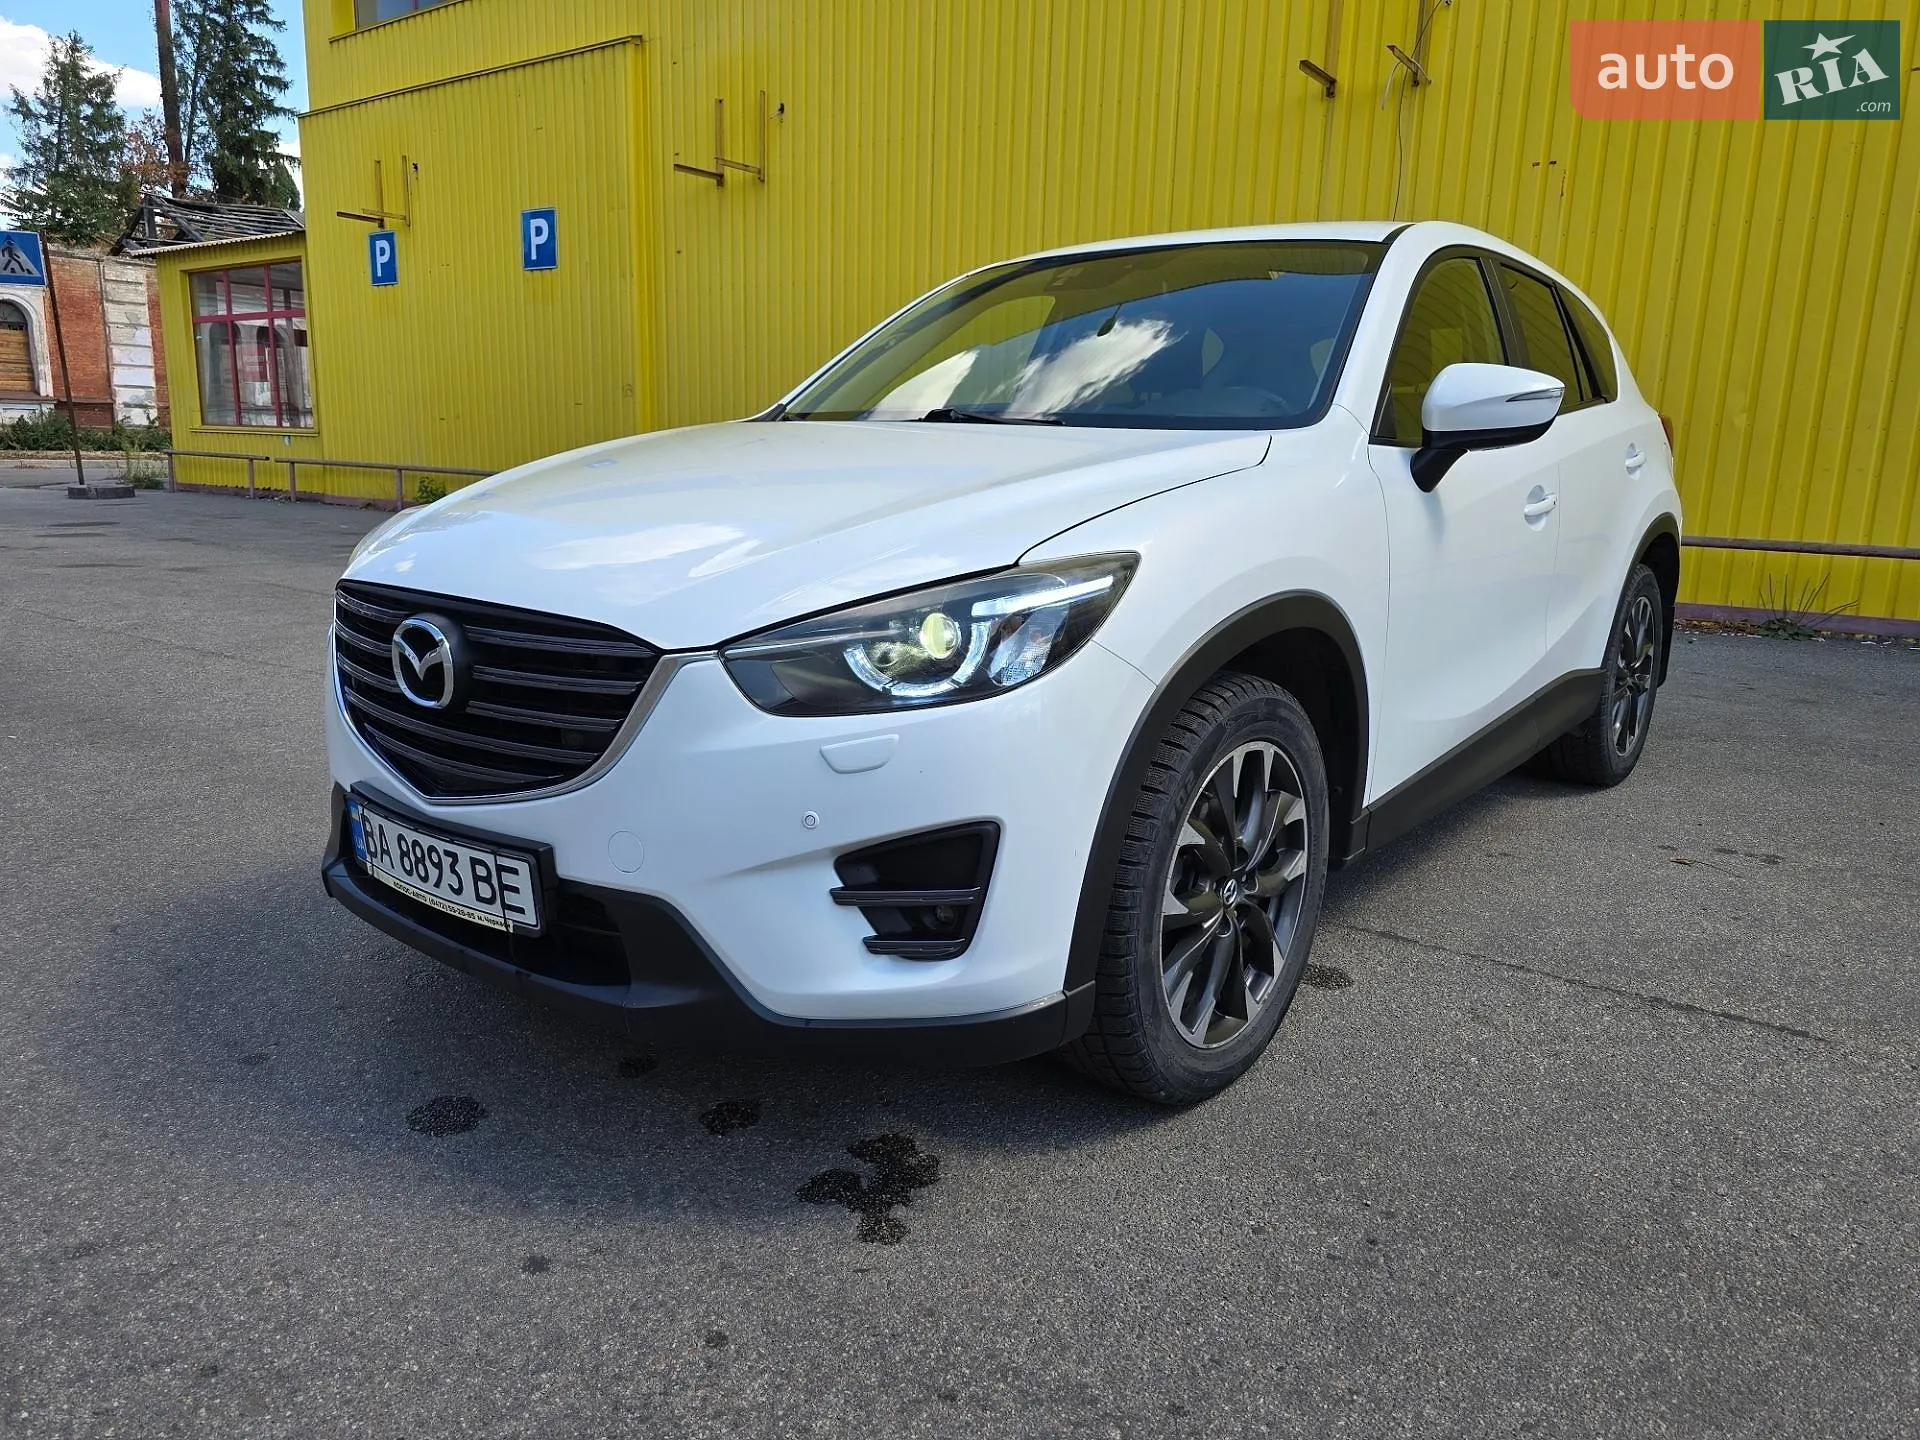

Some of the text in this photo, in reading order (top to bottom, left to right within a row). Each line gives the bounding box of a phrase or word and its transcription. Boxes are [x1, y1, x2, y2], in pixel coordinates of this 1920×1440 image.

[375, 240, 391, 277] P
[530, 218, 549, 260] P
[361, 813, 526, 915] BA 8893 BE
